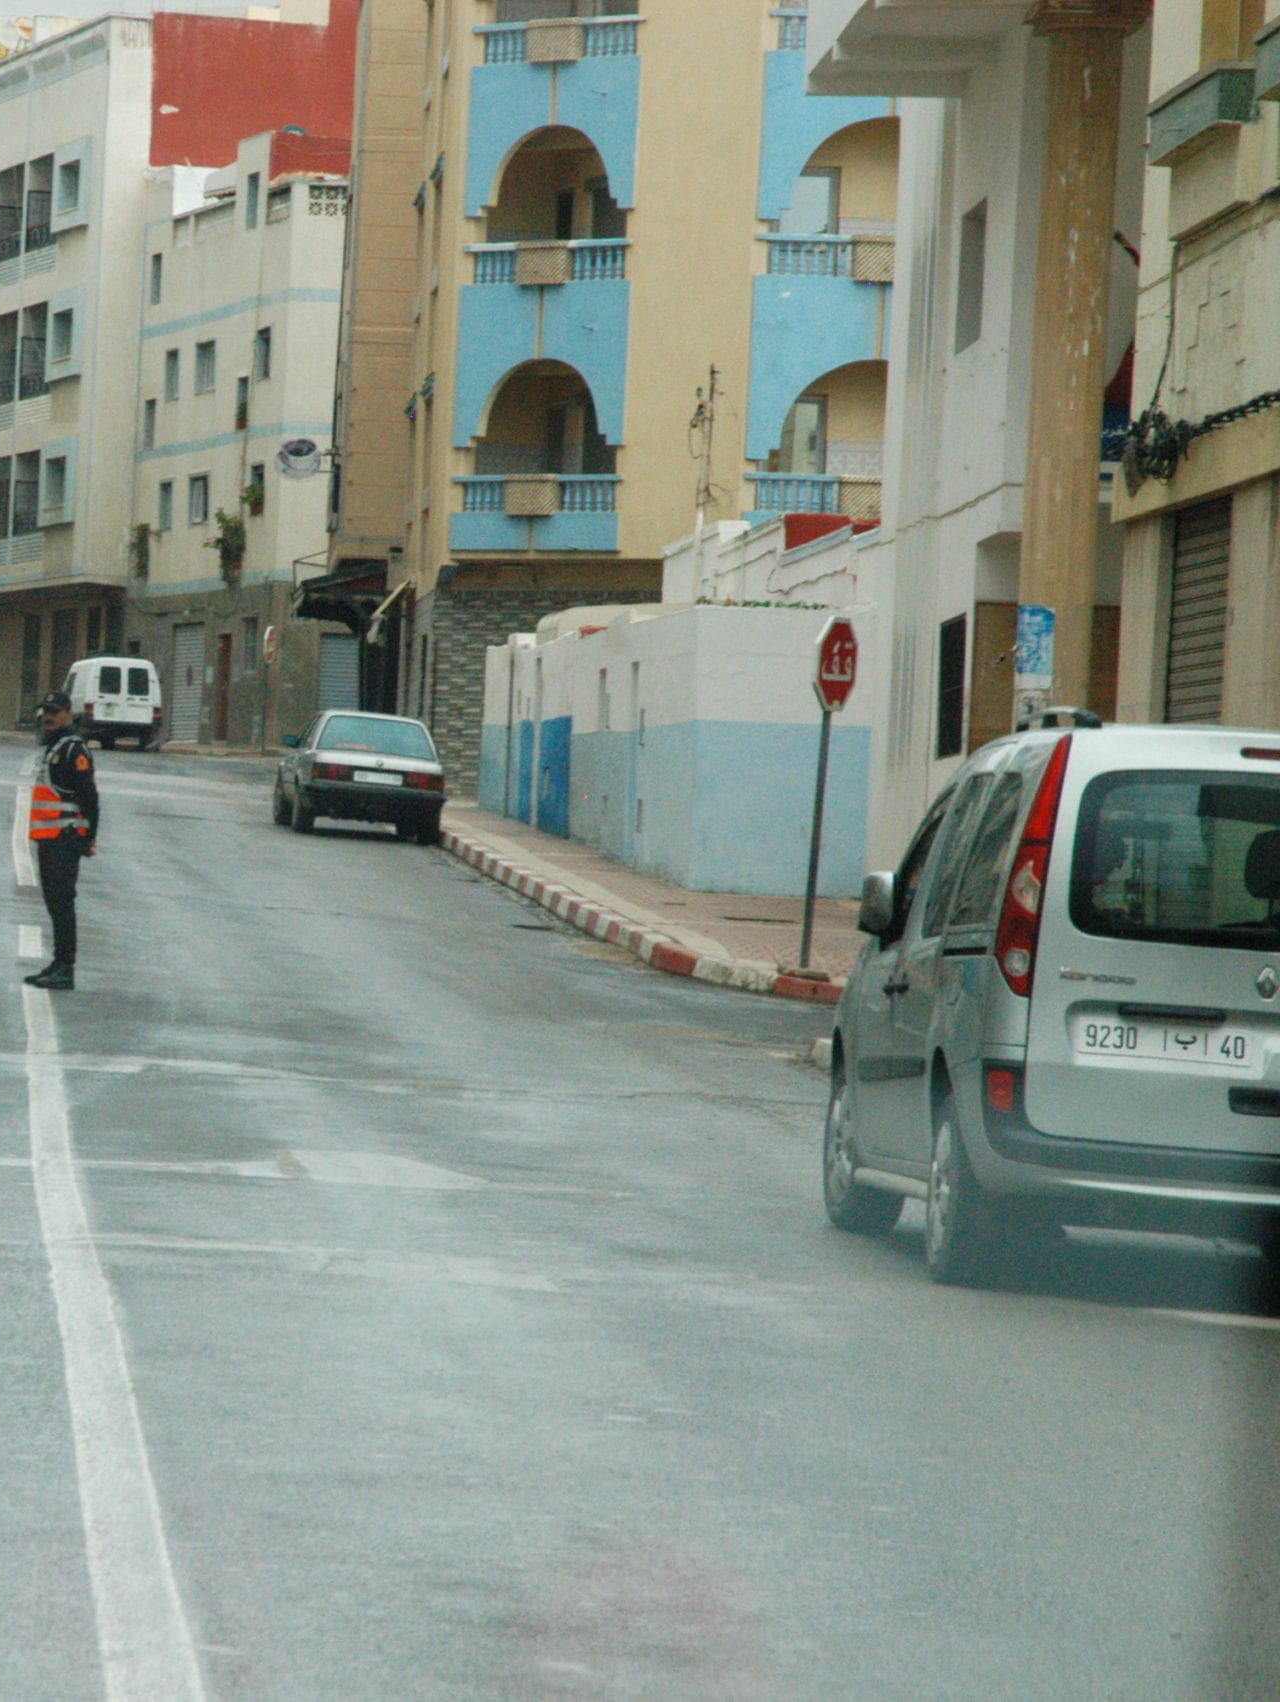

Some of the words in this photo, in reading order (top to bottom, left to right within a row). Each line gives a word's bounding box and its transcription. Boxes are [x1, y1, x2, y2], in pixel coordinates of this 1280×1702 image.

[1086, 1024, 1137, 1050] 9230
[1174, 1032, 1197, 1051] ب
[1220, 1034, 1246, 1060] 40
